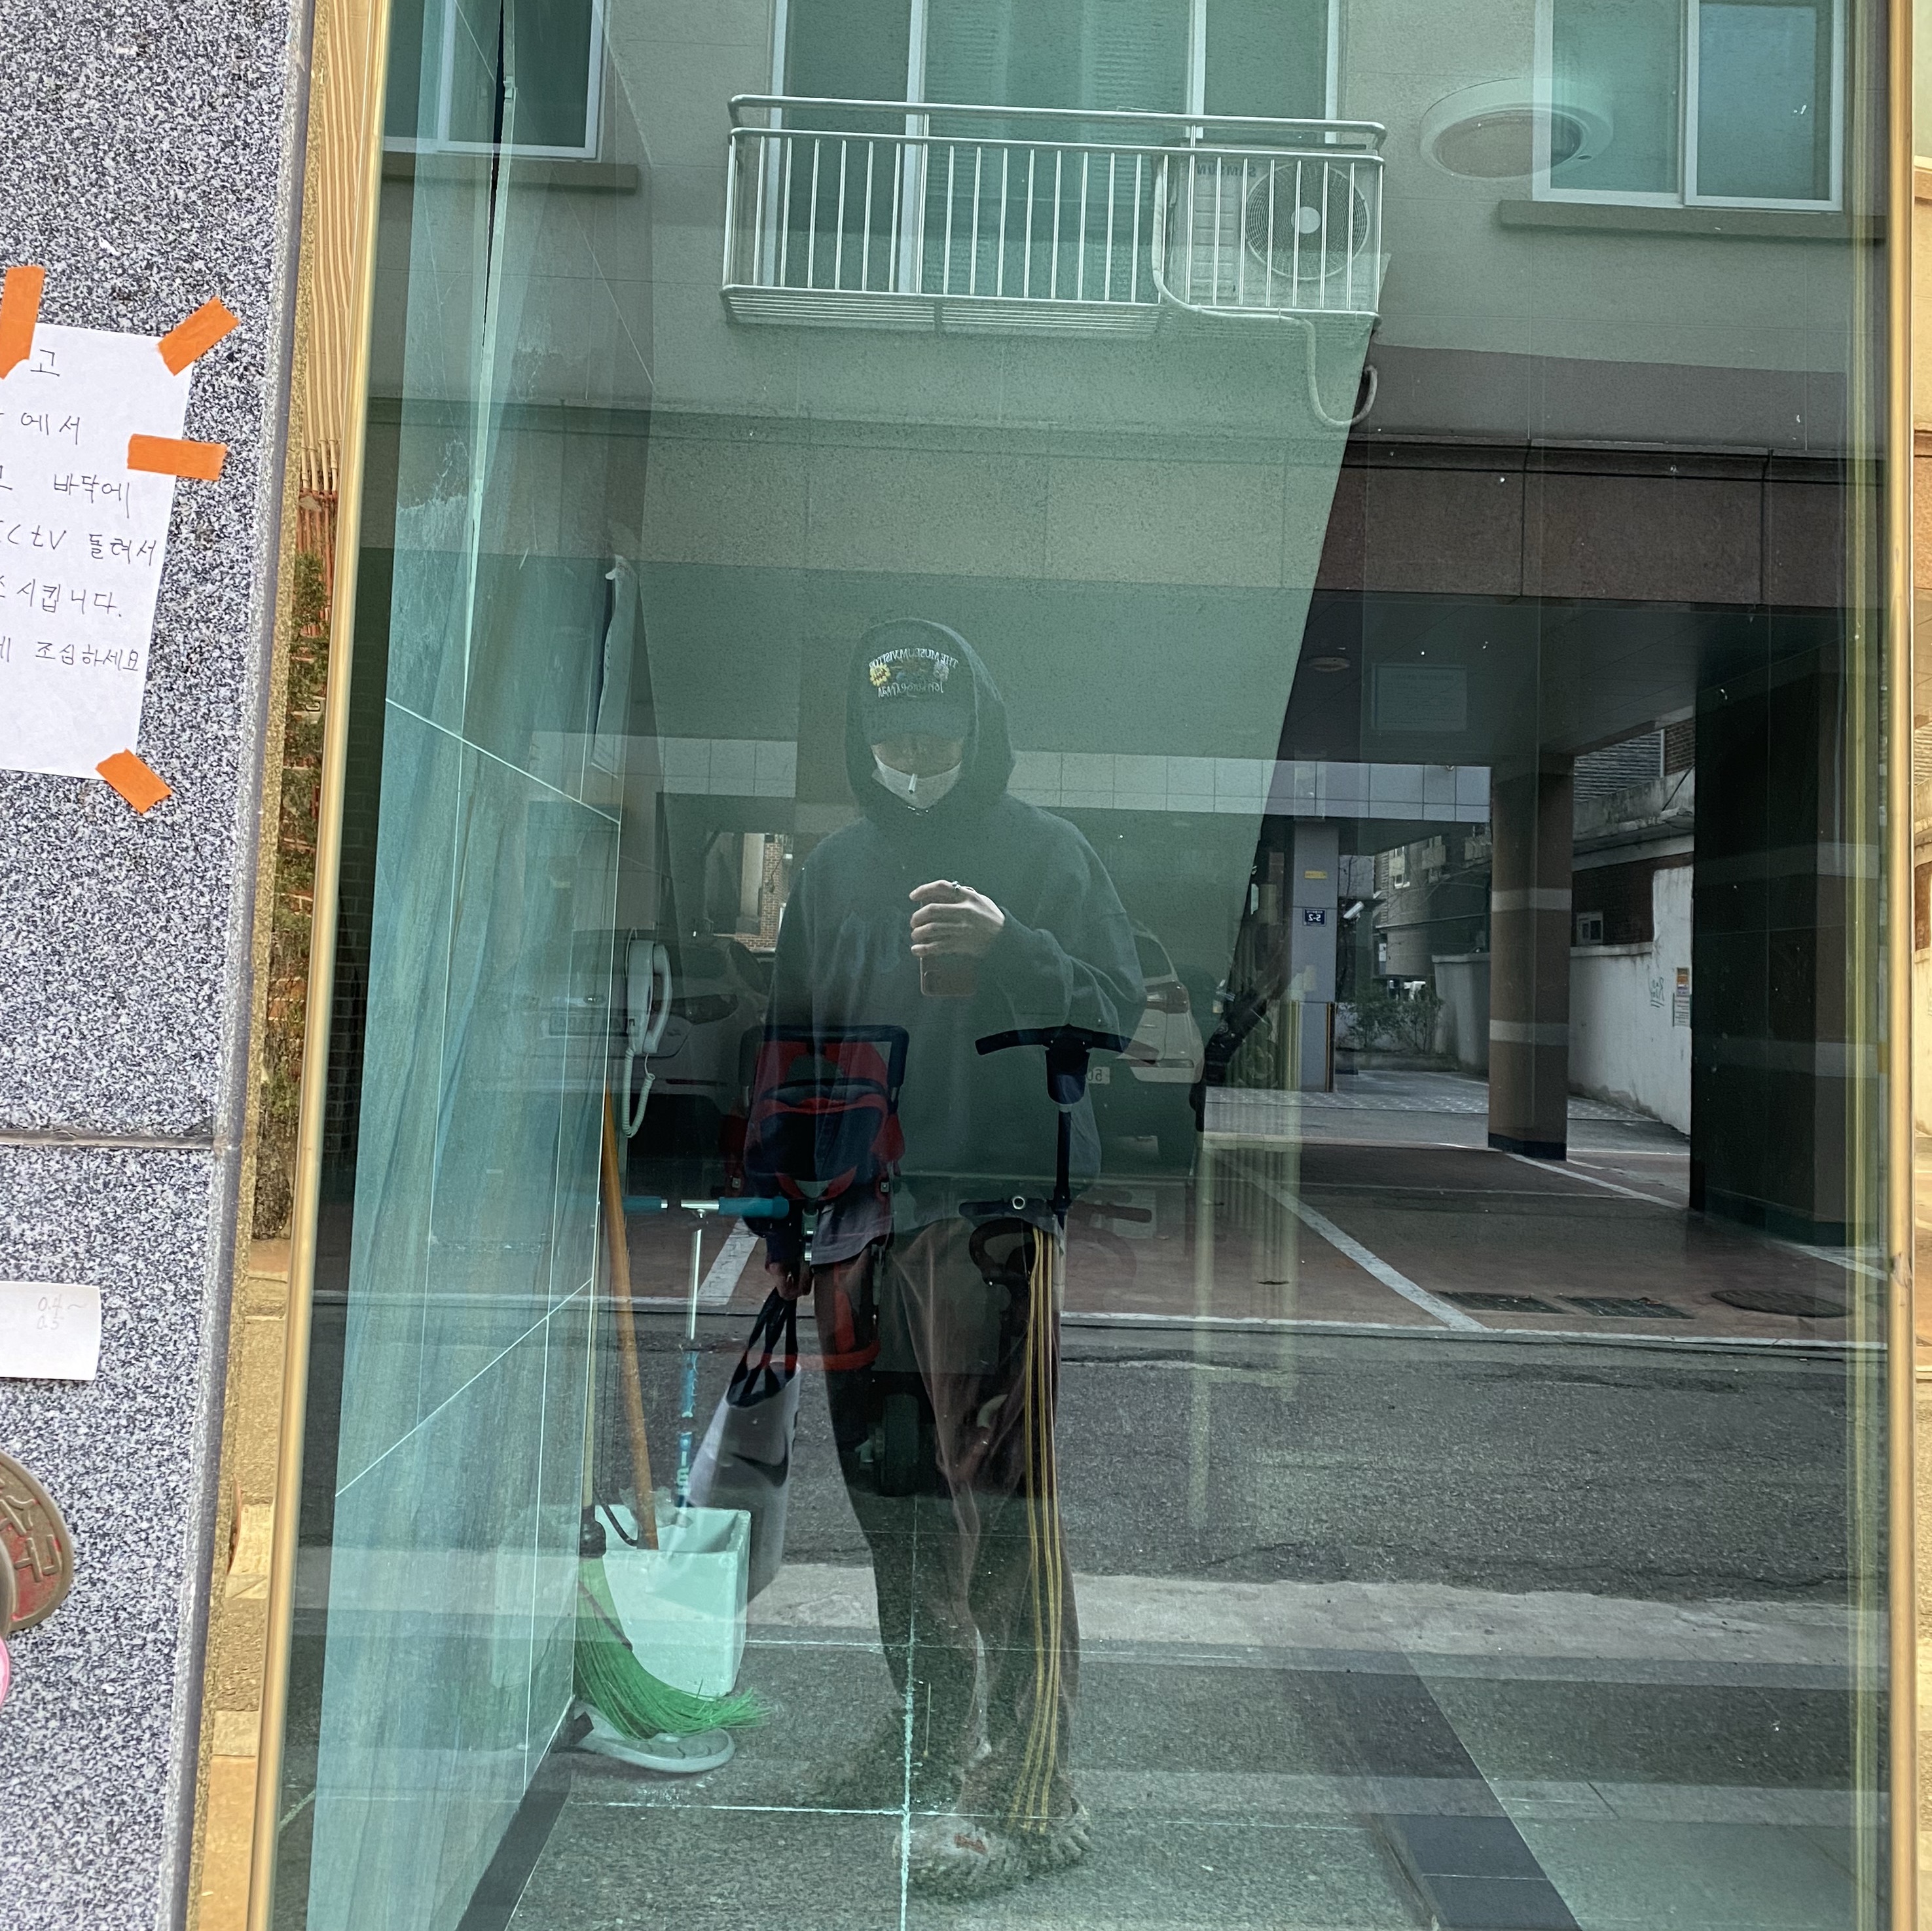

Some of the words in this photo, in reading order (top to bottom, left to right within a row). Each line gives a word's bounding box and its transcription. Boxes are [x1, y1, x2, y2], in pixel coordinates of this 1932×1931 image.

[30, 349, 60, 376] 고
[54, 473, 130, 518] 바닥에
[0, 520, 67, 550] CtV
[0, 576, 122, 617] 시킵니다.
[35, 641, 138, 672] 조심하세요
